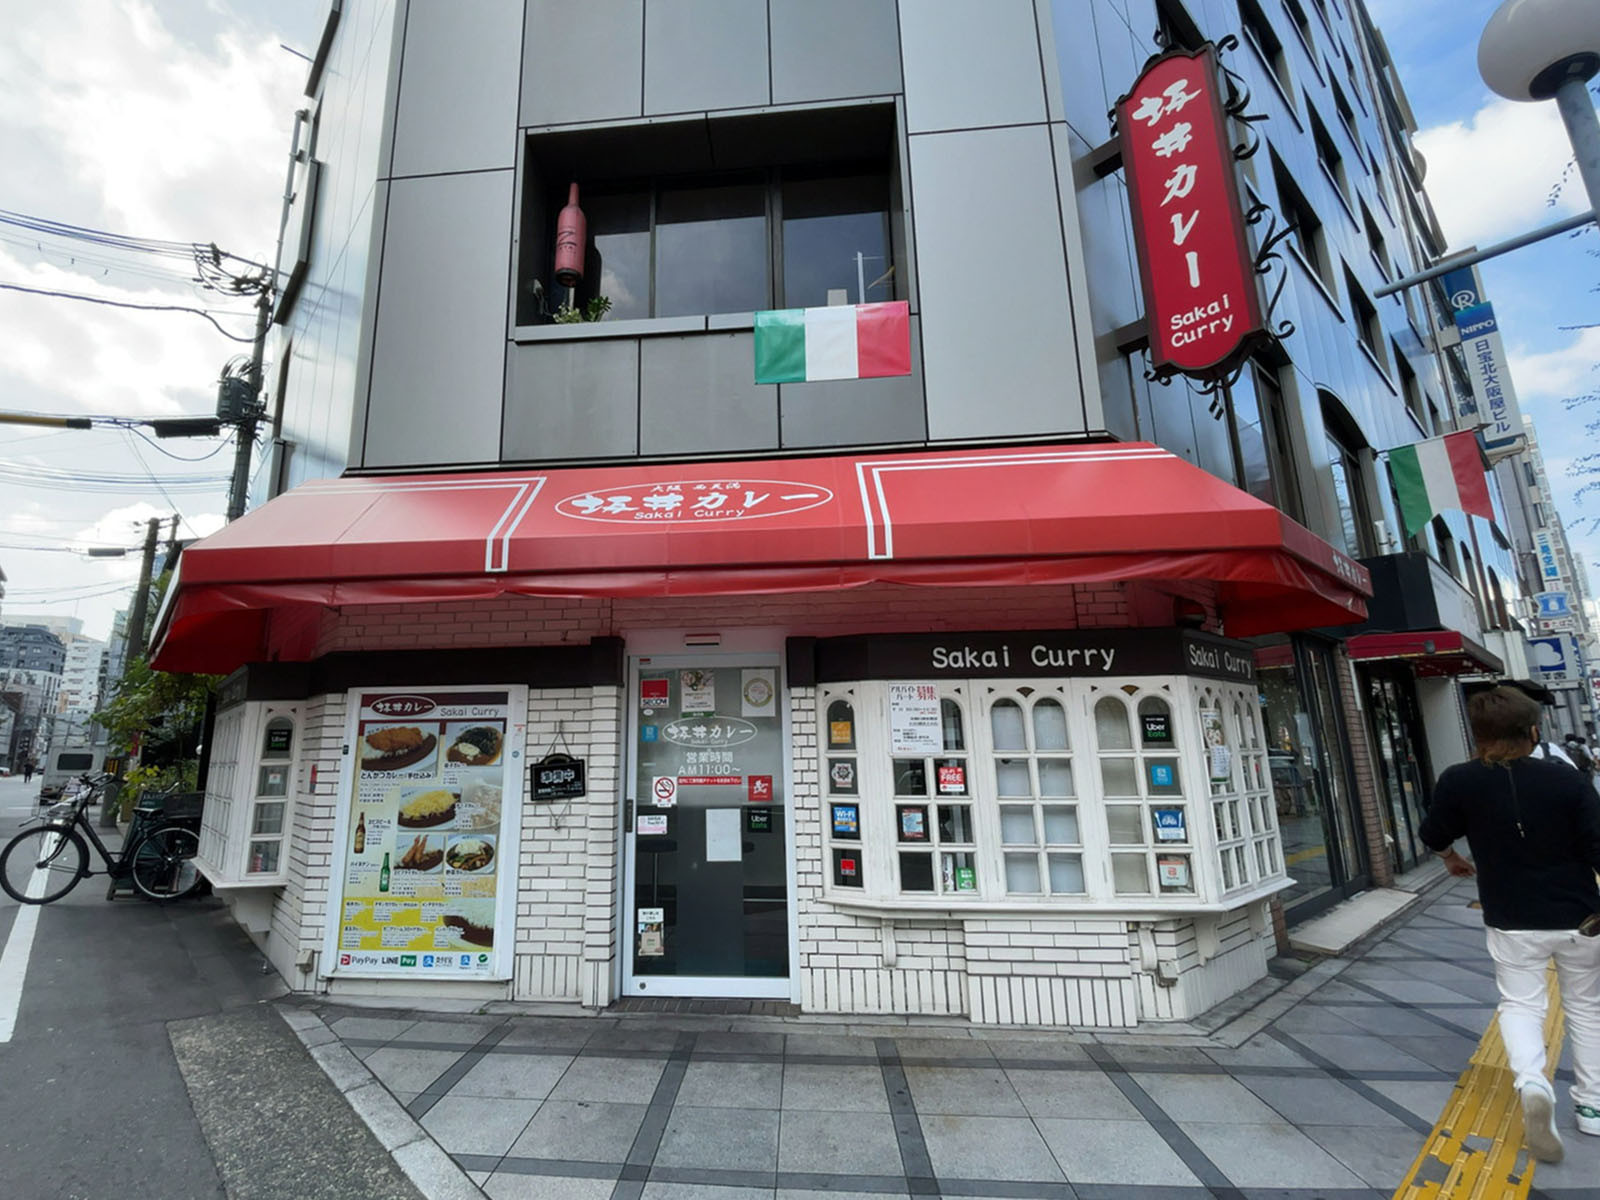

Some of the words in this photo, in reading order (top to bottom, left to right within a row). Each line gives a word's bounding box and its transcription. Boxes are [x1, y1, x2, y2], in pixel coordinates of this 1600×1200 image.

[1131, 78, 1202, 288] 坂井カレー
[1170, 293, 1230, 331] Sakai
[1170, 314, 1234, 348] Curry
[1461, 319, 1494, 336] NIPPO
[571, 490, 819, 515] 坂井カレー
[634, 509, 682, 520] Sakai
[694, 507, 745, 519] Curry
[932, 646, 1011, 669] Sakai
[1030, 645, 1115, 671] Curry
[1189, 644, 1220, 669] Sakai
[1225, 650, 1252, 678] Curry
[440, 707, 468, 717] Sakai
[471, 706, 500, 718] Curry
[686, 751, 734, 764] 営業時間
[751, 815, 768, 823] Uber
[351, 956, 378, 965] PayPay
[382, 957, 399, 965] LINE
